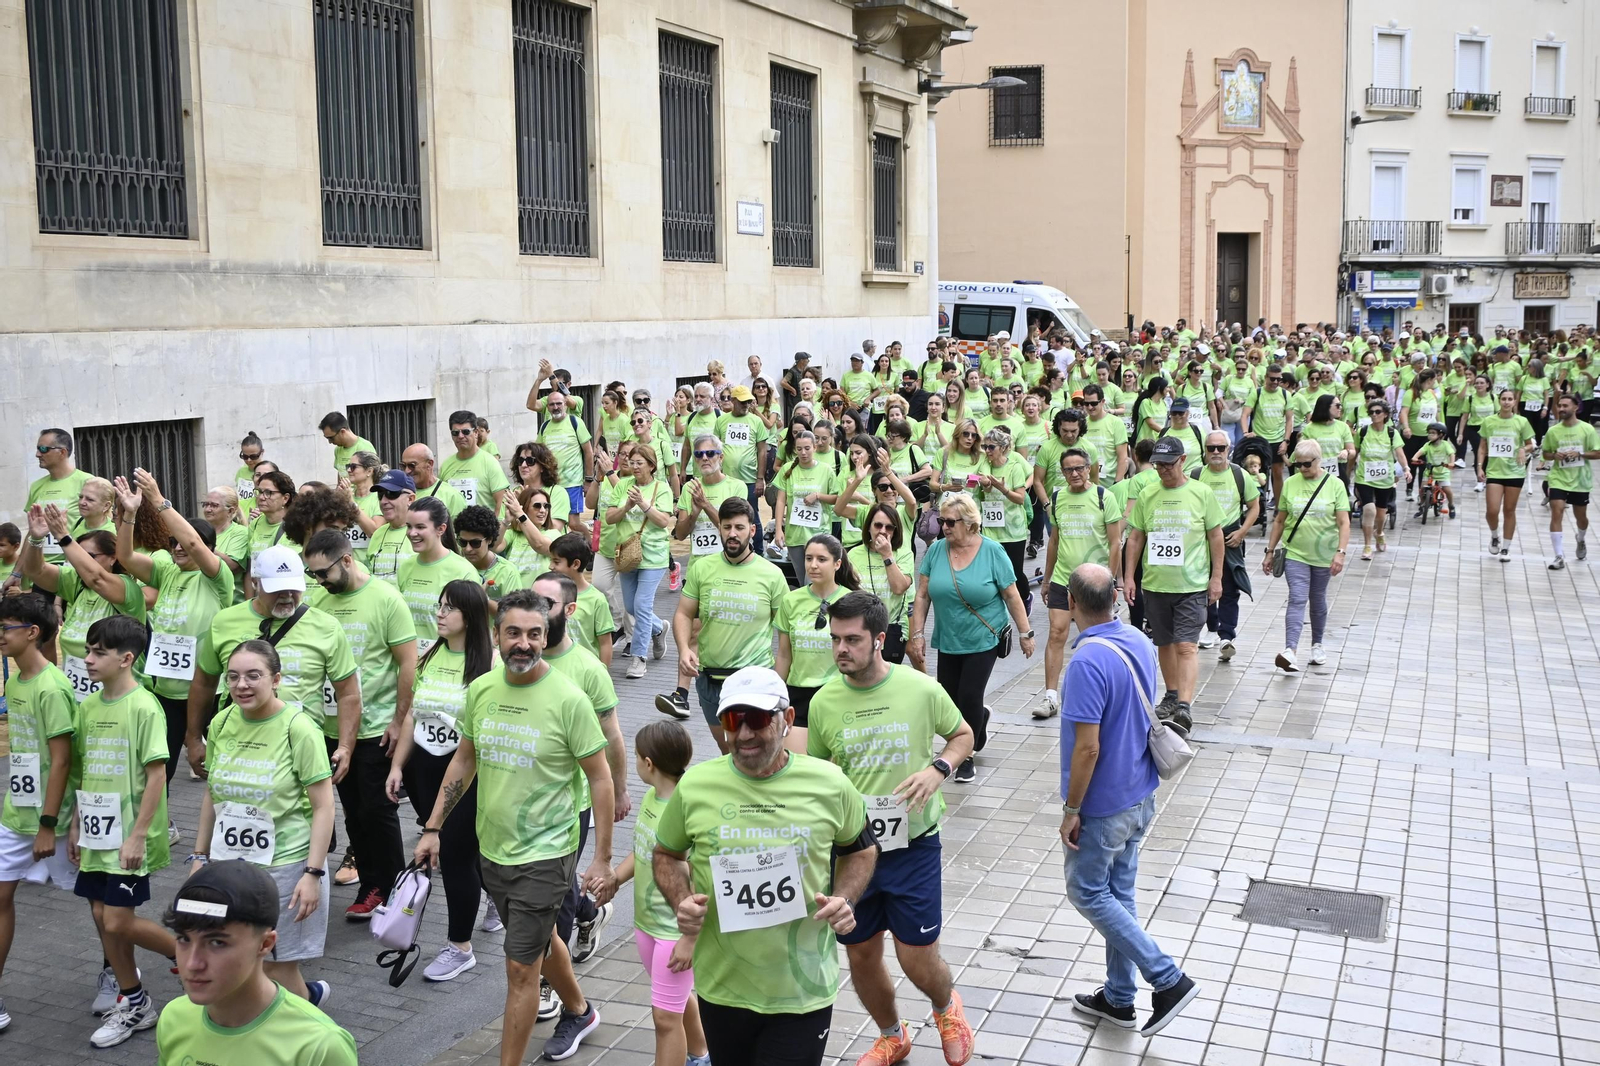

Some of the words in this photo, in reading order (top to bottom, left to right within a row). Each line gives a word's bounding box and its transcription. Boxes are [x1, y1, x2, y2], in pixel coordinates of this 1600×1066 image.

[938, 284, 977, 292] CCION
[1521, 276, 1528, 291] LA
[1532, 276, 1563, 291] TRAVIESA
[794, 506, 819, 522] 3425
[1151, 542, 1182, 557] 2289
[711, 588, 721, 597] En
[723, 591, 759, 602] marcha
[709, 599, 745, 610] contra
[746, 602, 757, 612] el
[709, 609, 756, 623] cáncer
[343, 621, 367, 631] archa
[795, 637, 833, 649] cánce
[153, 646, 191, 669] 2355
[421, 721, 459, 744] 1564
[481, 718, 496, 729] En
[497, 721, 541, 738] marcha
[843, 728, 859, 739] En
[861, 720, 910, 736] marcha
[479, 733, 520, 749] contra
[521, 739, 537, 753] el
[844, 738, 893, 754] contra
[894, 735, 910, 748] el
[218, 753, 231, 765] En
[234, 756, 277, 771] marcha
[480, 747, 536, 769] cáncer
[850, 752, 911, 768] cáncer
[10, 774, 36, 794] 68
[213, 768, 257, 783] contra
[259, 774, 274, 786] el
[213, 780, 275, 802] cáncer
[219, 820, 269, 850] 1666
[719, 824, 747, 839] En
[751, 822, 811, 839] marcha
[870, 817, 903, 838] 97
[721, 875, 796, 910] 3466
